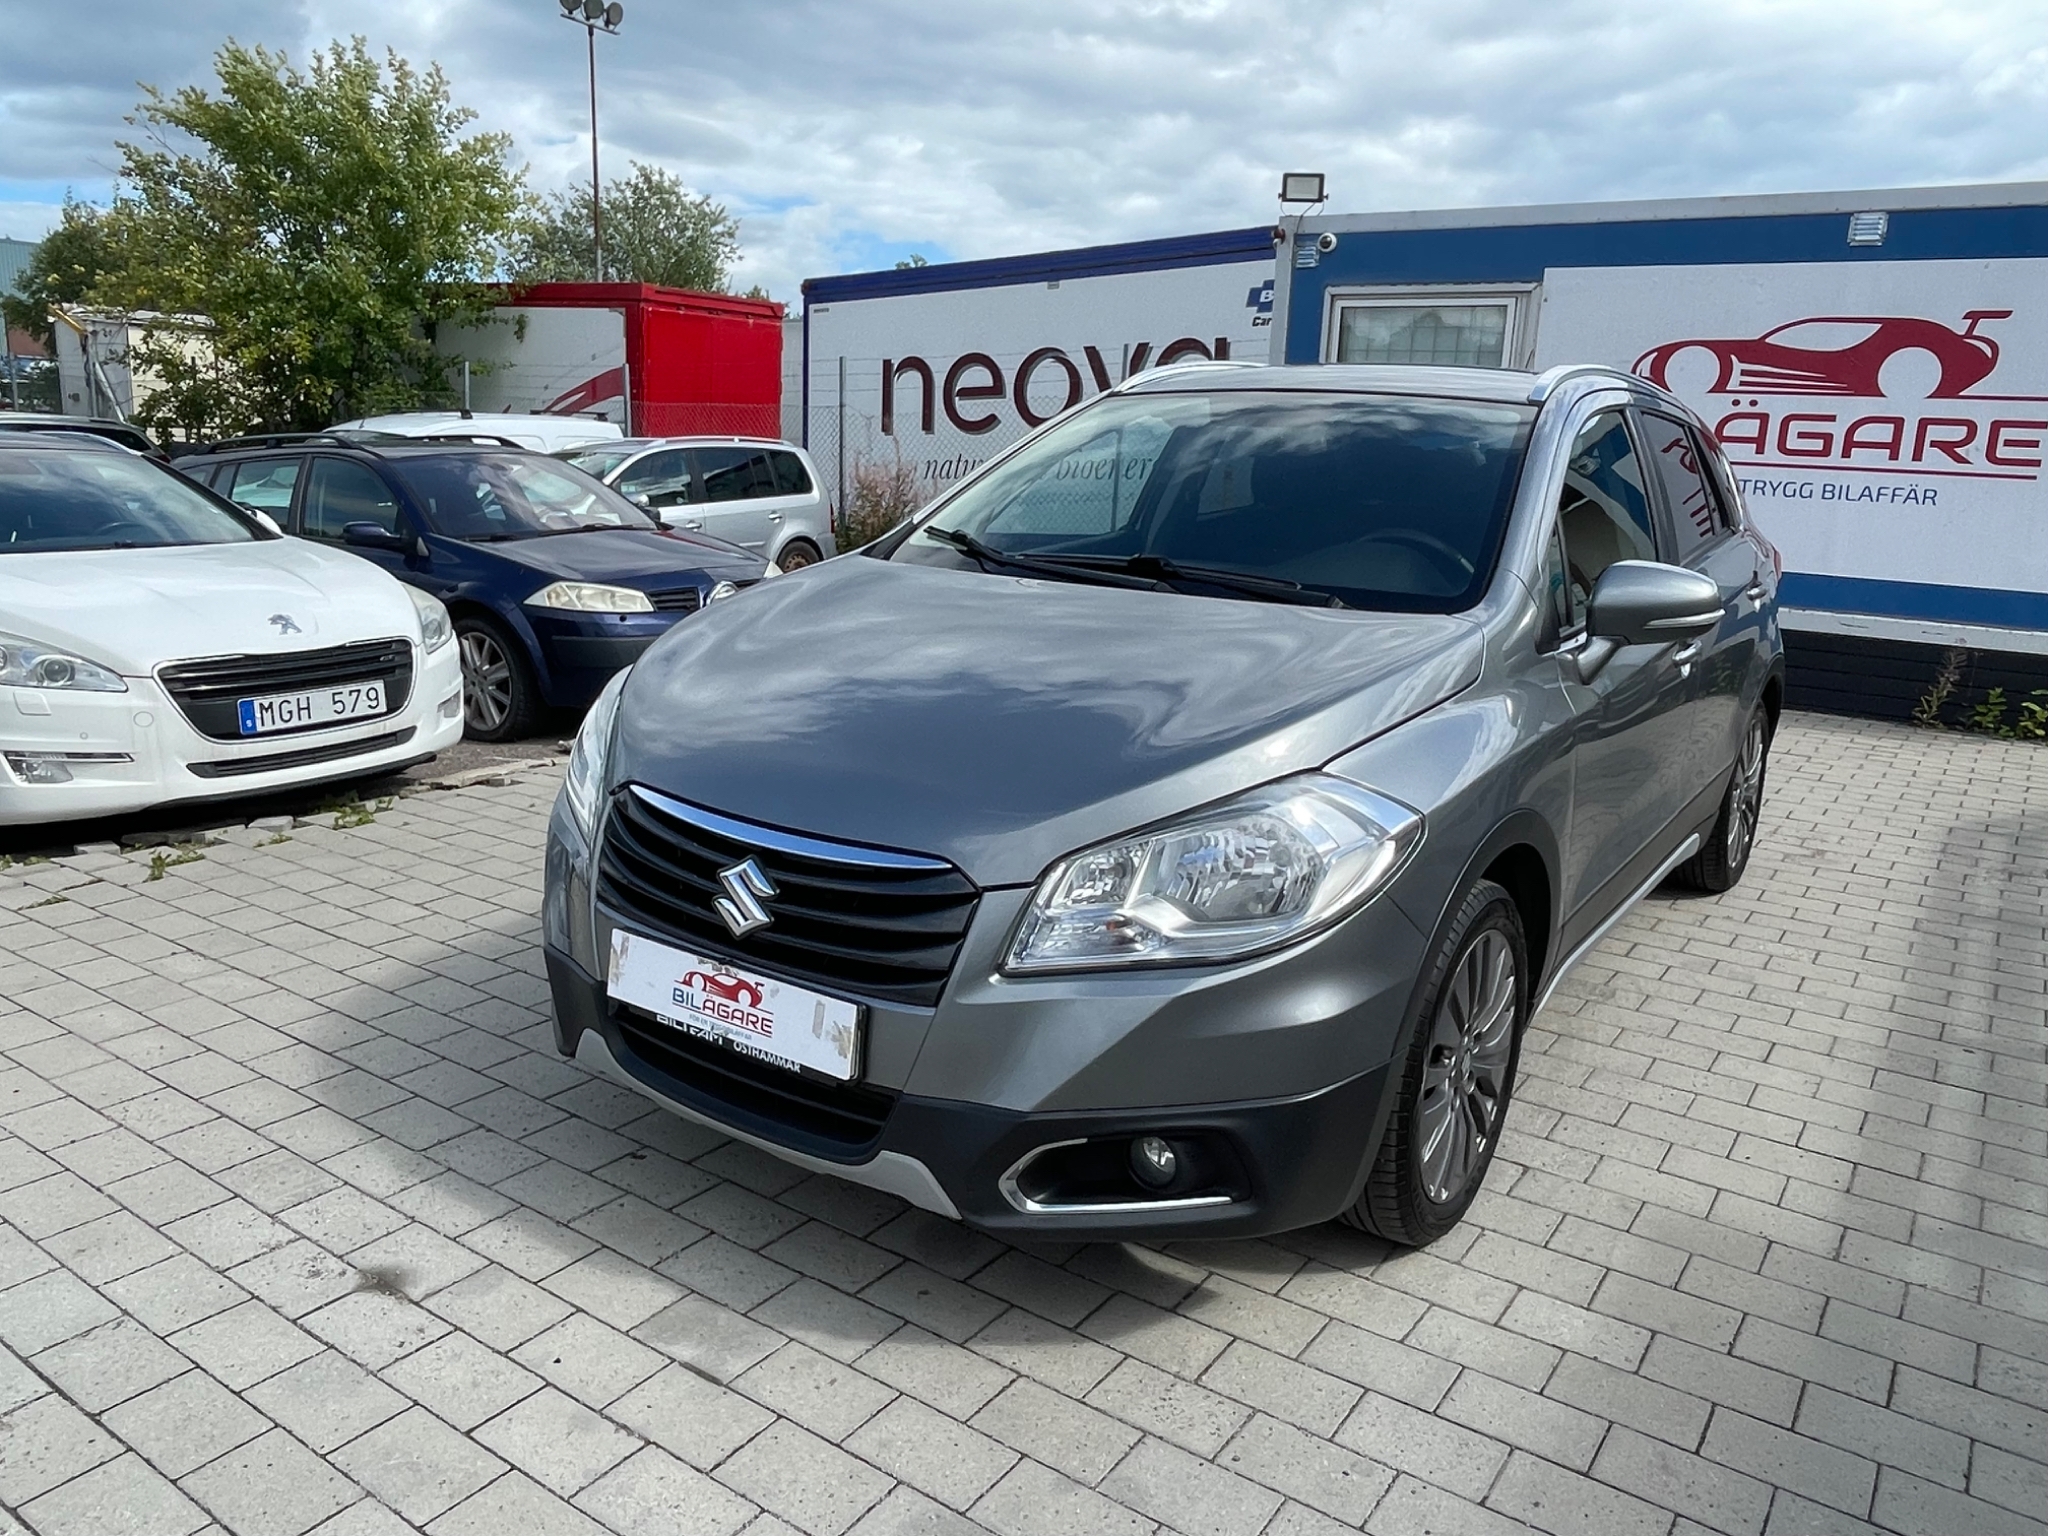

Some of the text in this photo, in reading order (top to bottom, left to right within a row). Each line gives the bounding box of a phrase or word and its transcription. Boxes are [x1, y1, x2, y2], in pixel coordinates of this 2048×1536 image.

[1739, 479, 1938, 507] TRYGG BILAFFÄR
[259, 696, 312, 727] MGH
[332, 687, 380, 715] 579
[672, 987, 774, 1035] BILÄGARE
